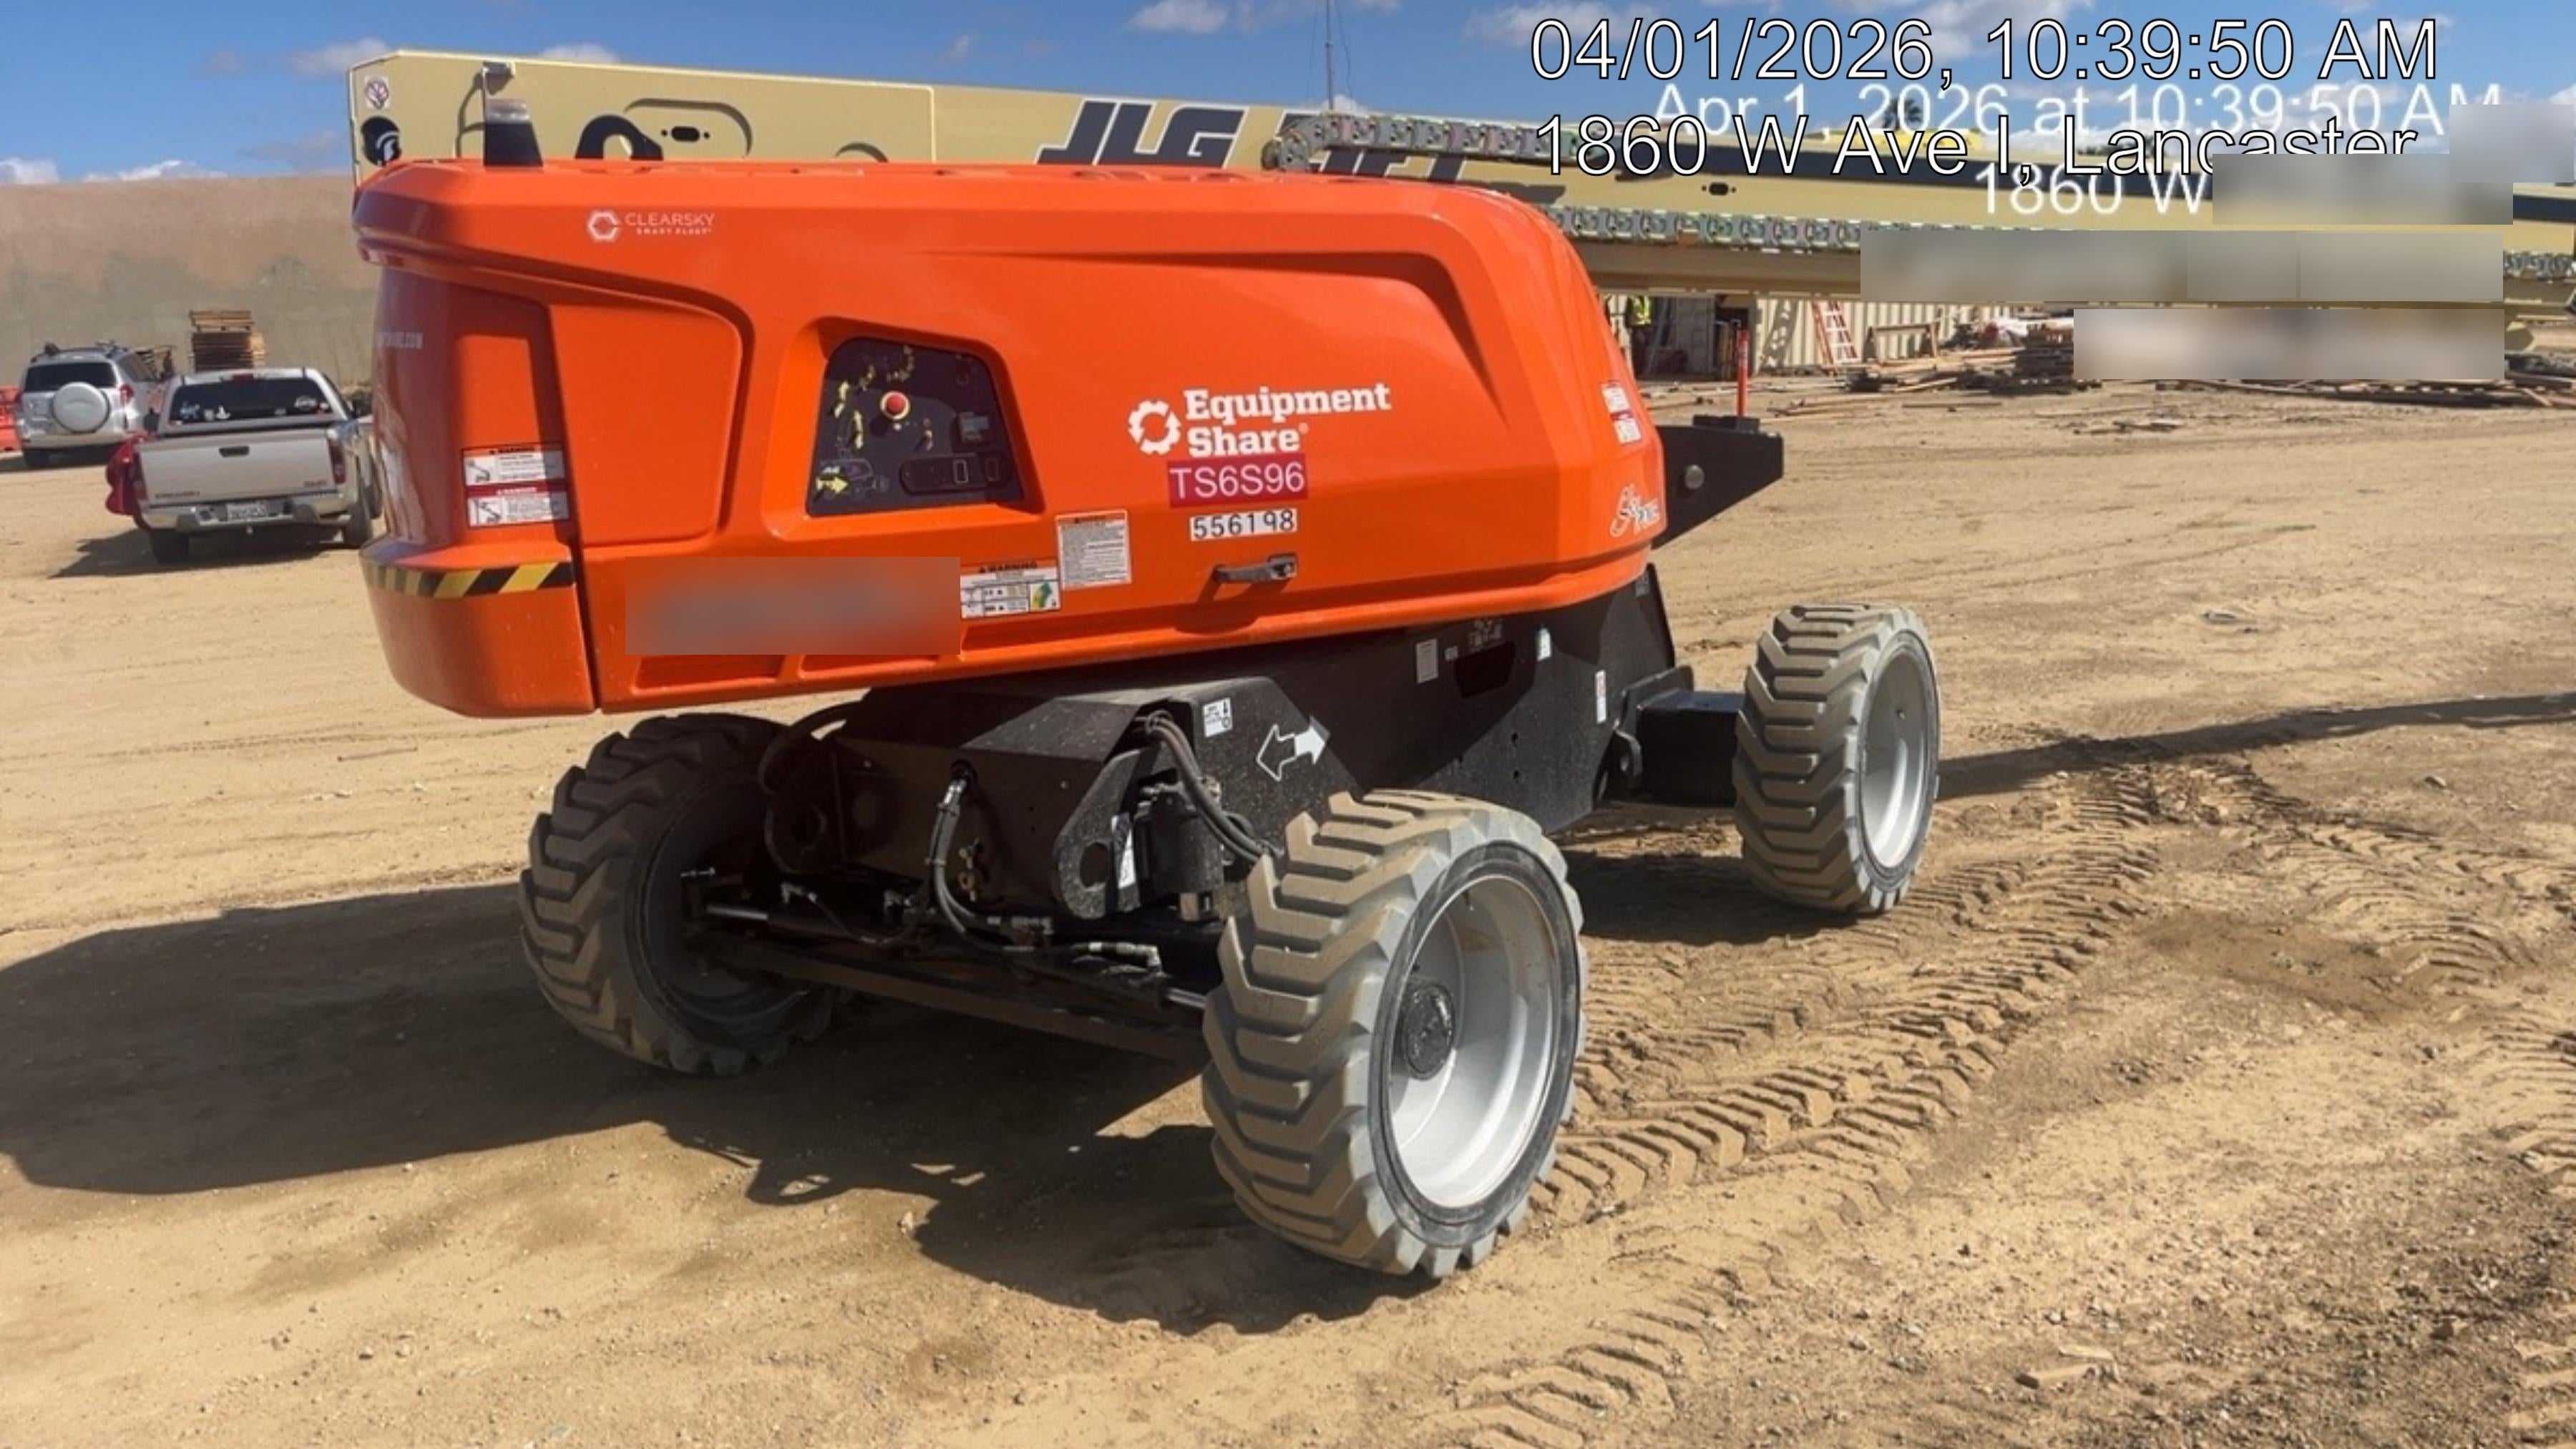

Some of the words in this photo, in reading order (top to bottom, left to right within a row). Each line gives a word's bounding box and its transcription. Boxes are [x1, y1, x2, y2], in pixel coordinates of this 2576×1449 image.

[1036, 97, 1249, 168] JLG
[624, 213, 716, 226] CLEARSKY
[1183, 382, 1392, 425] Equipment
[1187, 426, 1301, 458] Share
[1169, 462, 1305, 499] TS6S96
[1192, 509, 1296, 539] 556198
